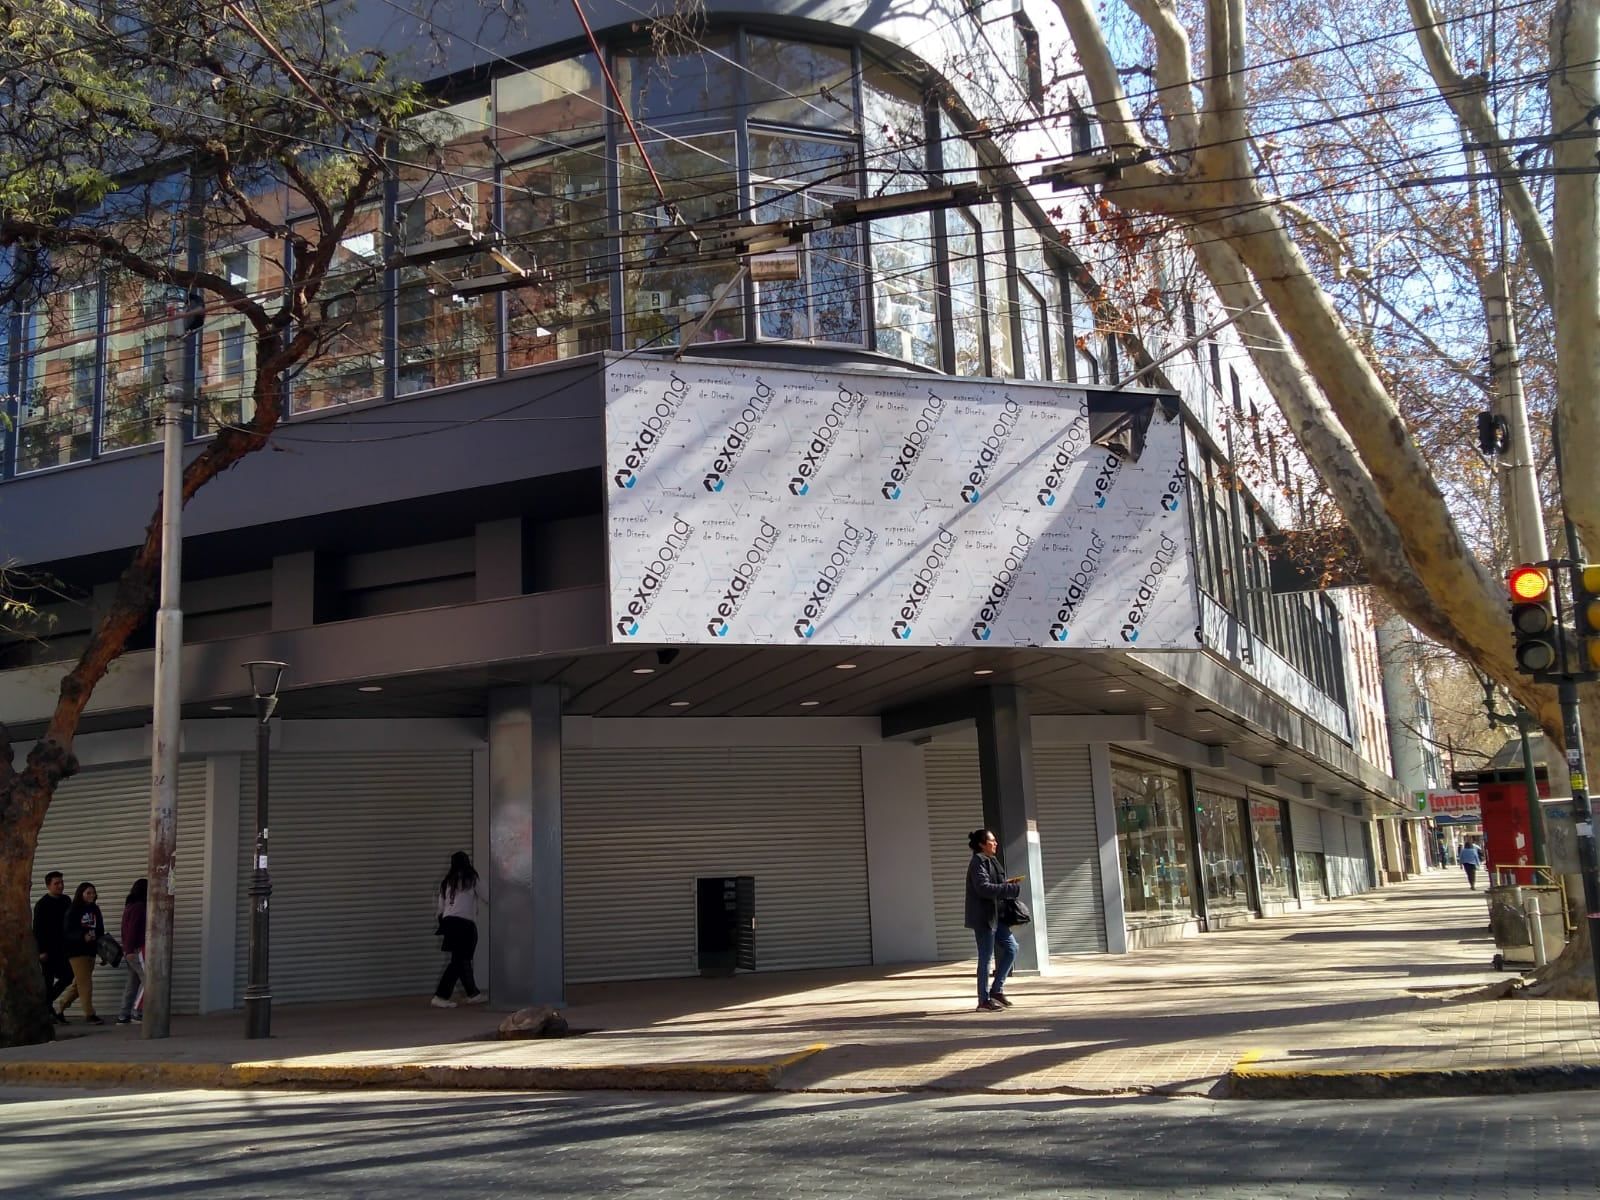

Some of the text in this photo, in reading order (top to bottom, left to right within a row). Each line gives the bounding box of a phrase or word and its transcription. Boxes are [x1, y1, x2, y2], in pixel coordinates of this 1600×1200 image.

[625, 374, 686, 469] exabond
[714, 379, 771, 473] exabond
[798, 384, 853, 477] exabond
[891, 391, 943, 481] exabond
[969, 396, 1019, 485] exabond
[628, 516, 690, 616] exabond
[718, 519, 776, 617] exabond
[804, 521, 859, 618] exabond
[901, 526, 953, 620] exabond
[981, 528, 1030, 622] exabond
[1129, 533, 1174, 624] exabond
[1428, 792, 1480, 808] farmac
